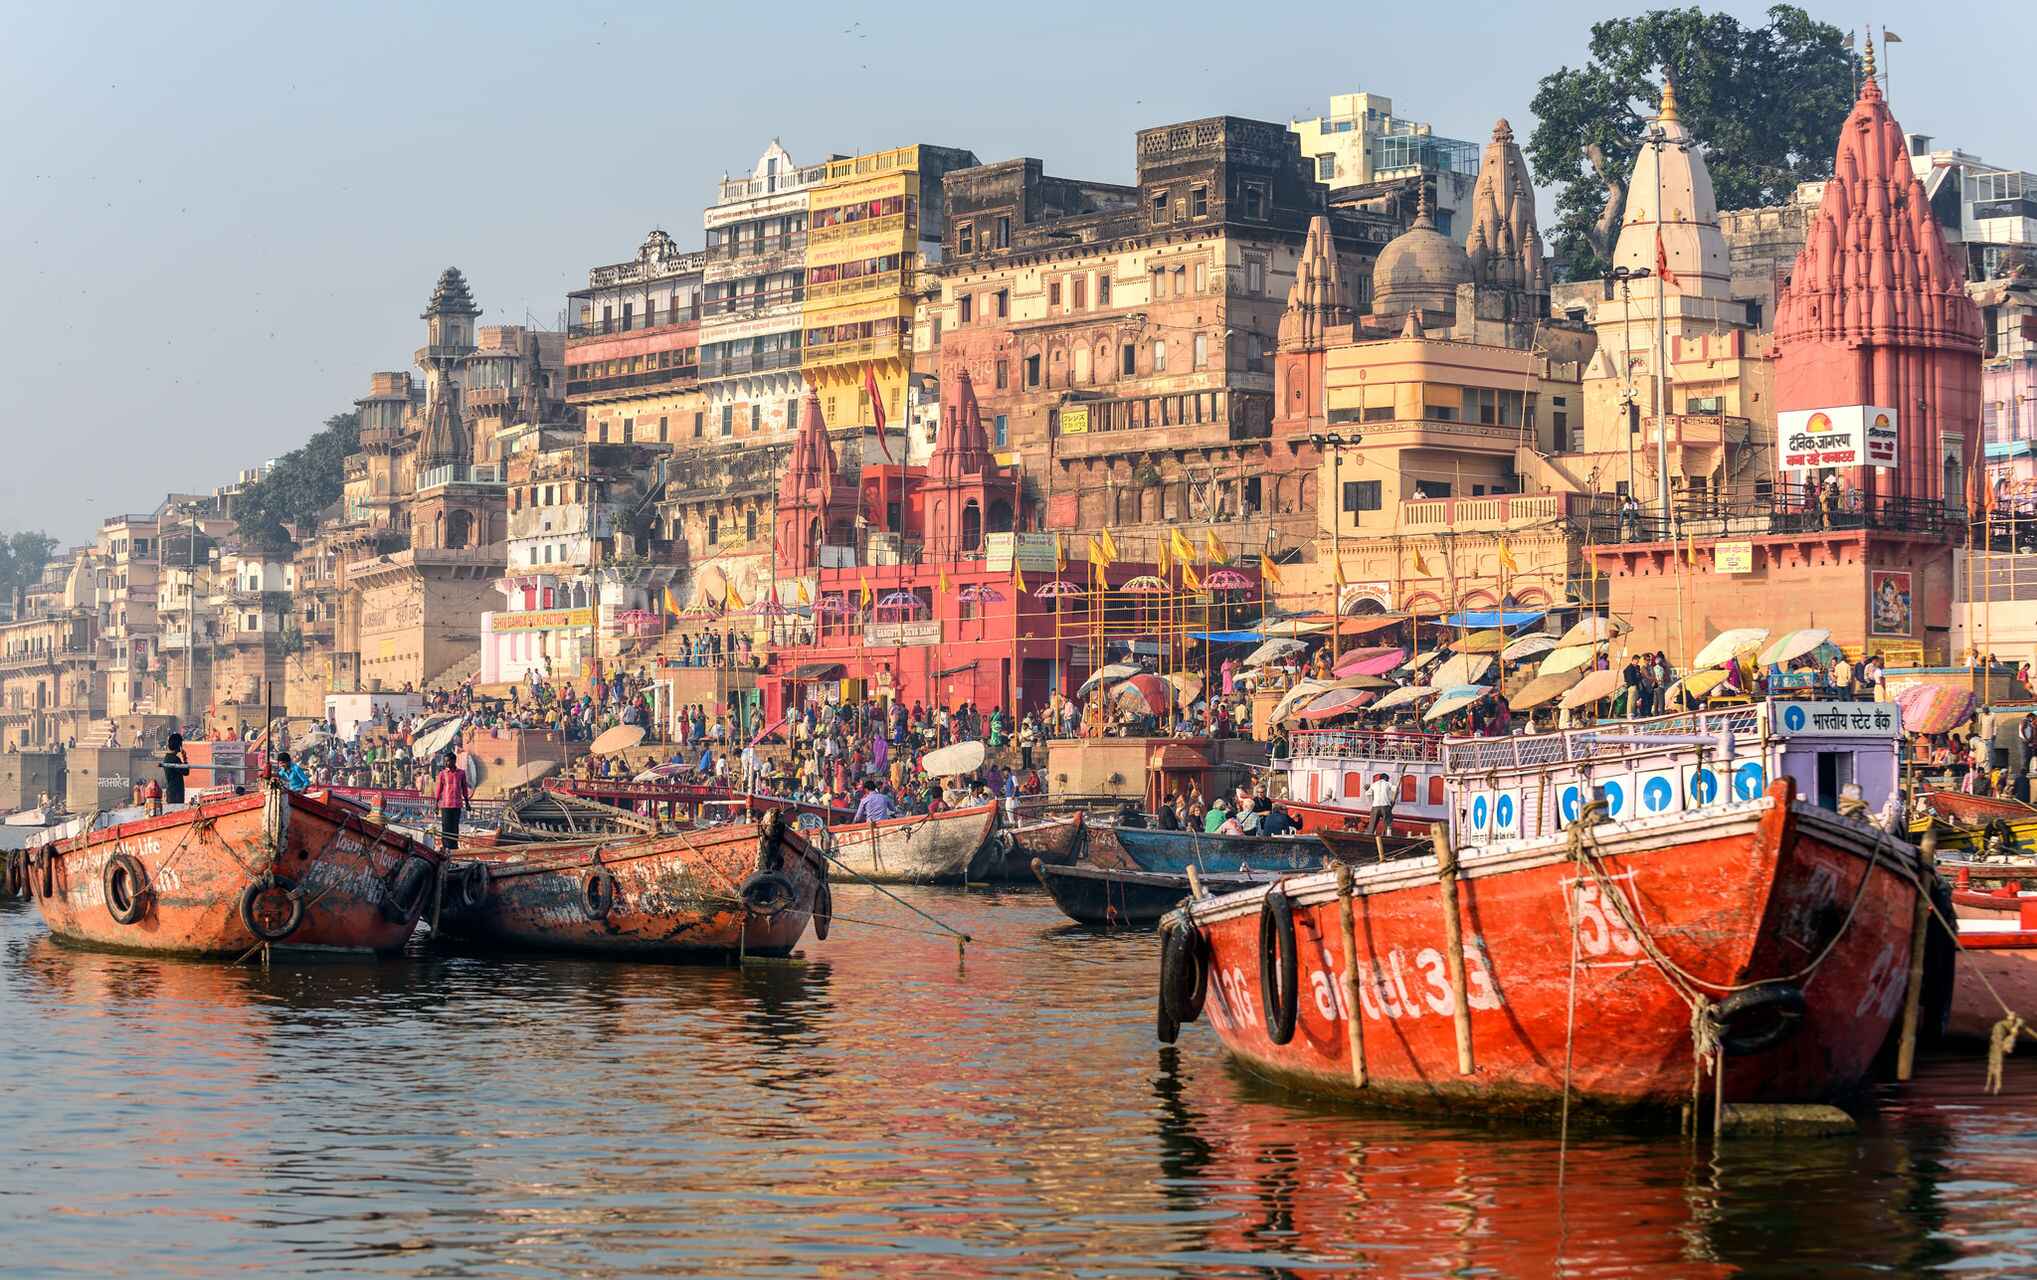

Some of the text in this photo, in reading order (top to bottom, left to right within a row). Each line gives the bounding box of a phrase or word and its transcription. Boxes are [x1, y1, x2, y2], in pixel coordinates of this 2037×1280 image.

[1789, 432, 1814, 451] दैनिक
[1815, 433, 1851, 449] जागरण
[1812, 706, 1891, 730] भारतीय स्टेट बैंक
